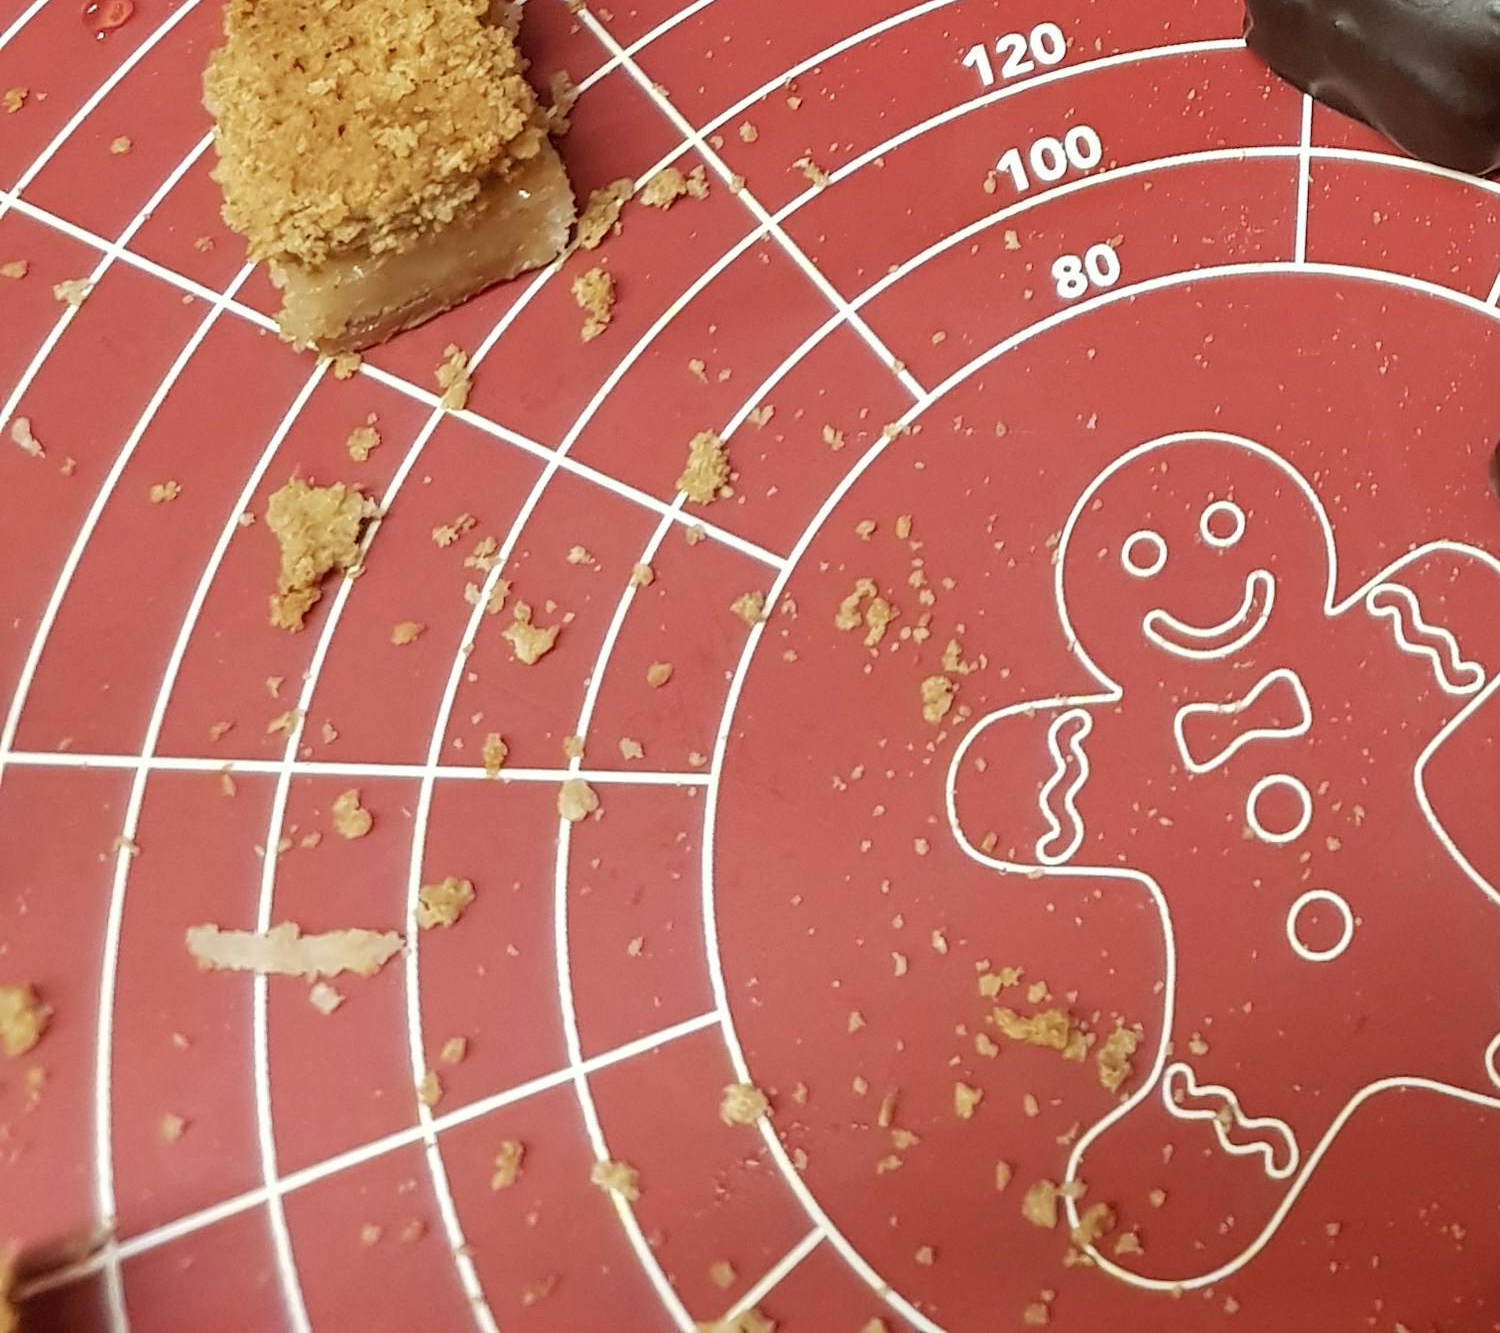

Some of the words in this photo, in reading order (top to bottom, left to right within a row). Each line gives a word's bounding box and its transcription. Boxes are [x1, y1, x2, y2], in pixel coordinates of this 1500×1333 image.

[961, 21, 1068, 87] 120
[996, 124, 1103, 193] 100
[1050, 242, 1121, 299] 80
